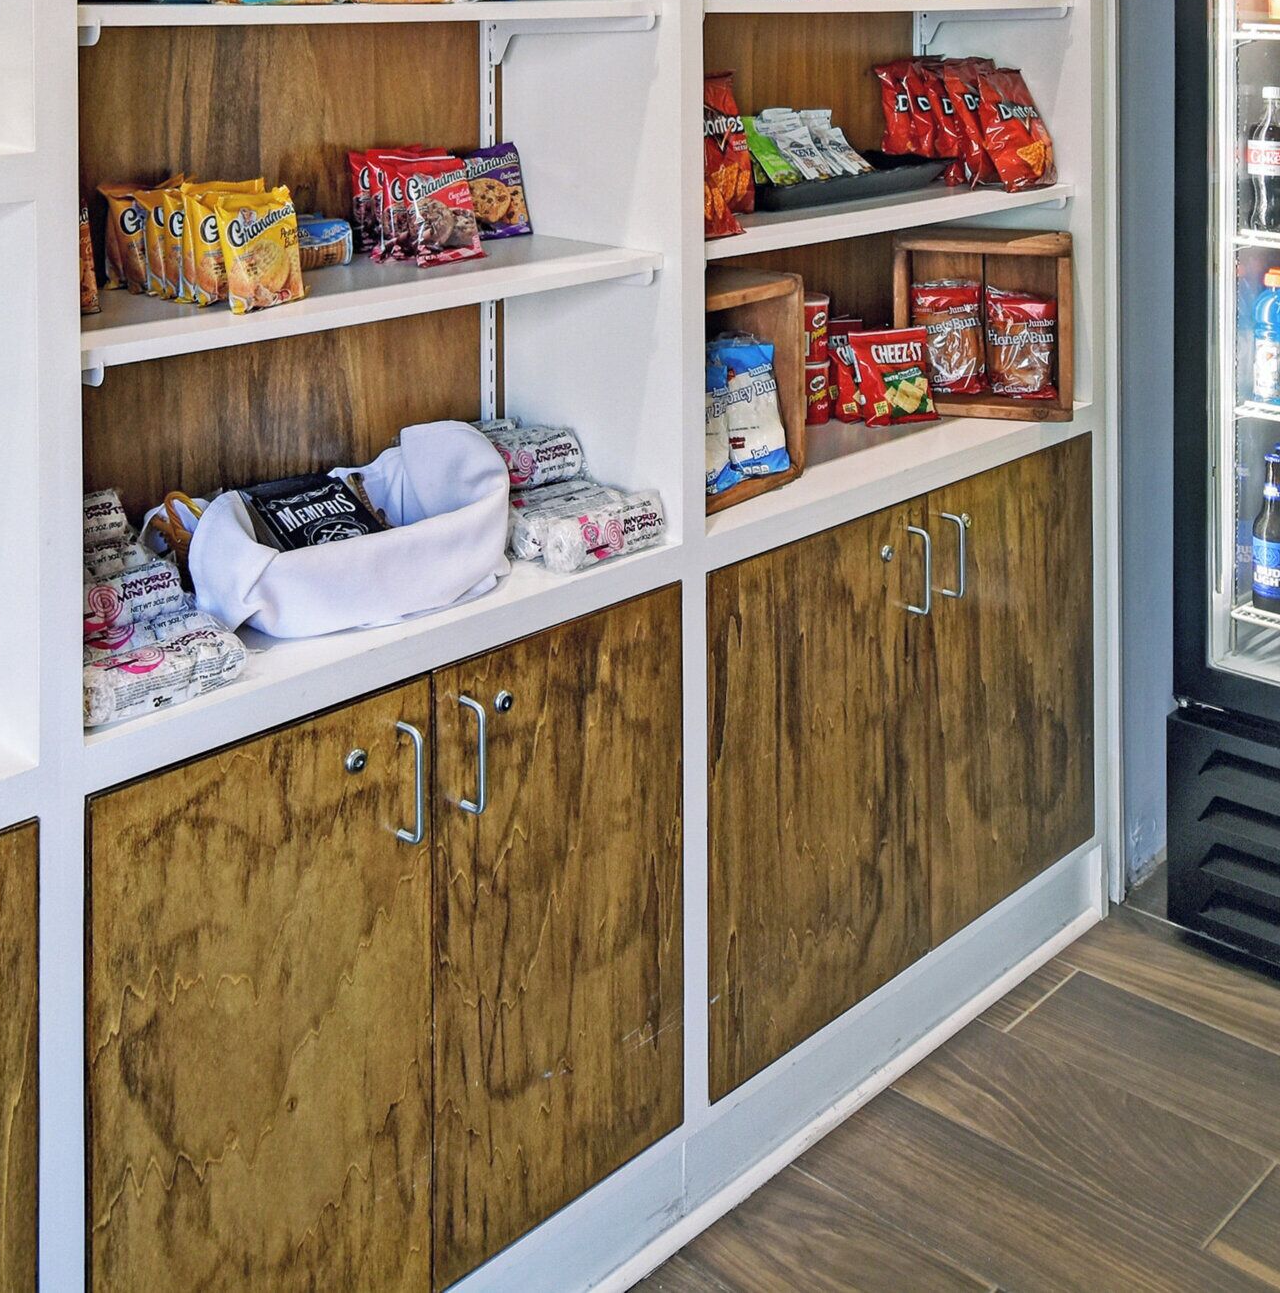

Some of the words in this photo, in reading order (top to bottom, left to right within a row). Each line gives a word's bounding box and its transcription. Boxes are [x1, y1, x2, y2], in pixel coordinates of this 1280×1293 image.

[1030, 333, 1054, 344] Bun
[727, 386, 753, 405] oney
[753, 378, 777, 396] Bun
[276, 493, 356, 533] MEMPHIS
[121, 571, 172, 591] POWDERED
